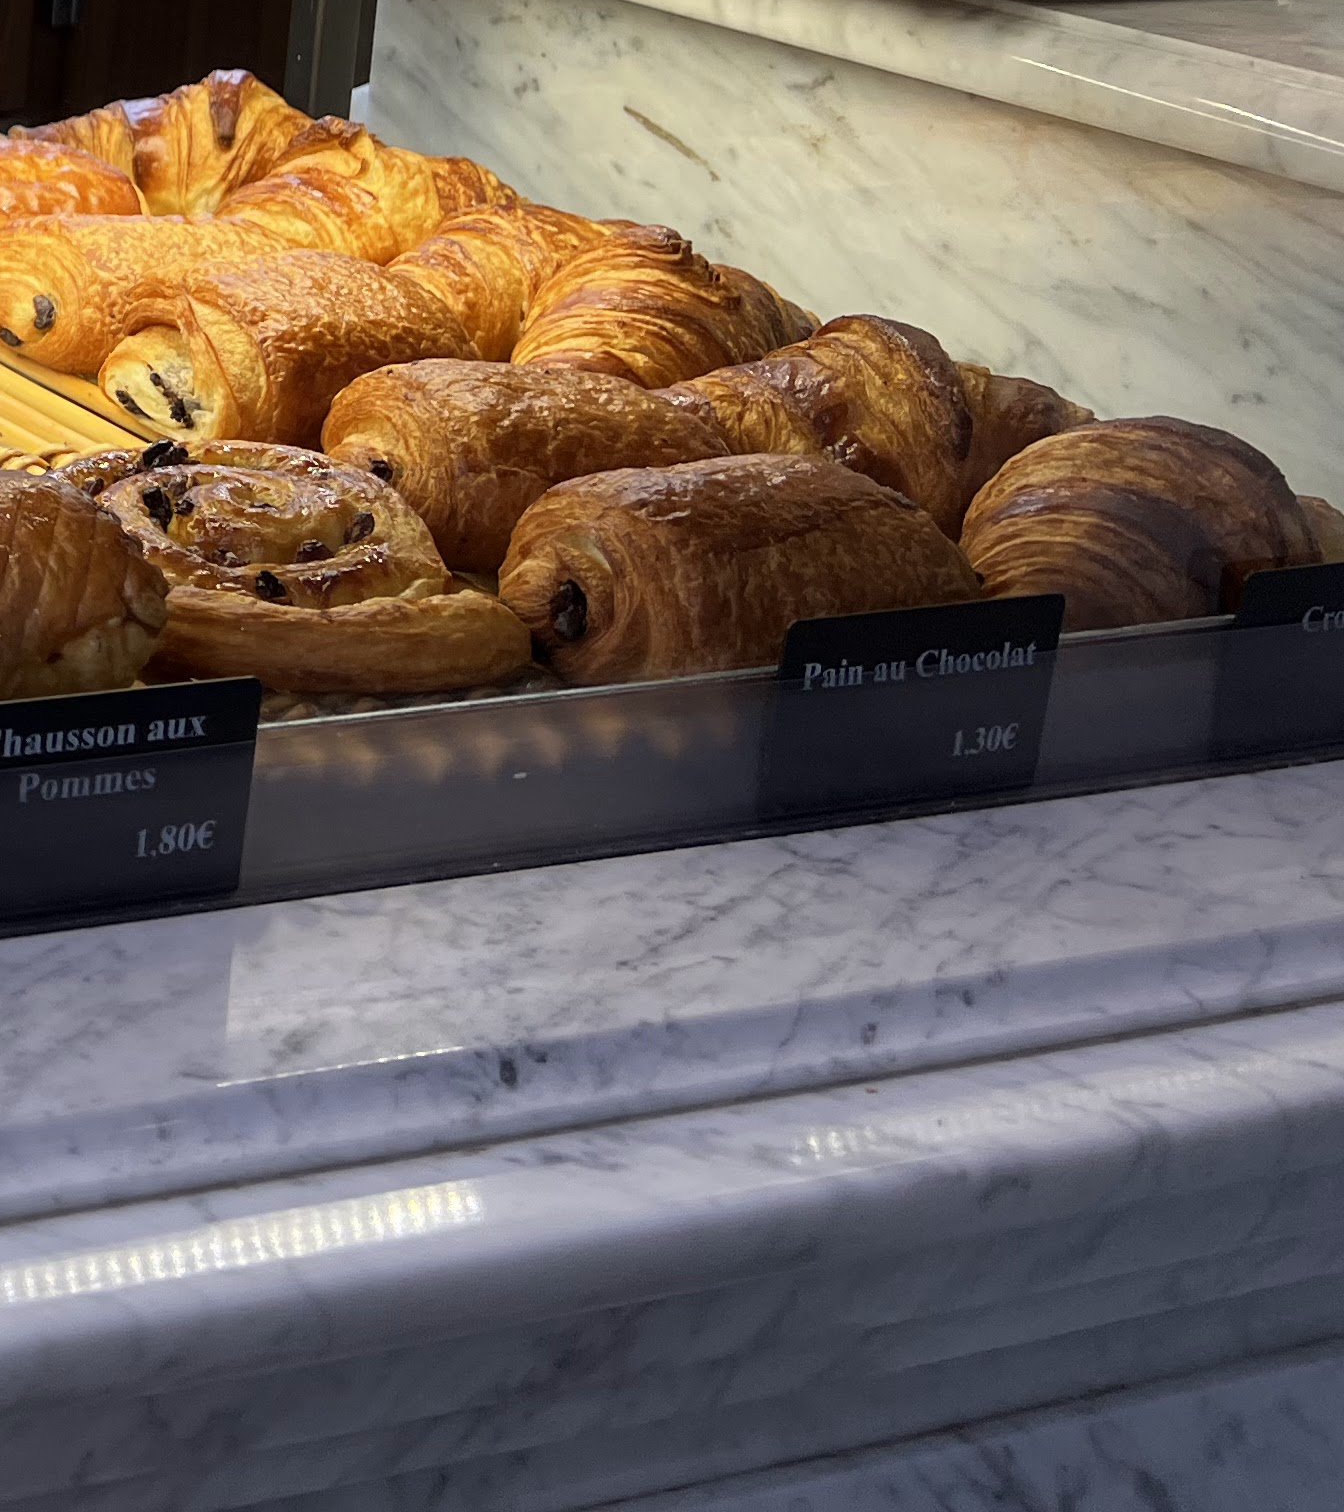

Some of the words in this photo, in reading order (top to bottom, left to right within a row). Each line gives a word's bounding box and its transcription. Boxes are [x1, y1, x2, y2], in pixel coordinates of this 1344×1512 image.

[803, 659, 863, 691] Pain
[873, 663, 906, 685] au
[915, 642, 1037, 679] Chocolat
[147, 715, 208, 743] aux
[18, 766, 157, 804] Pommes
